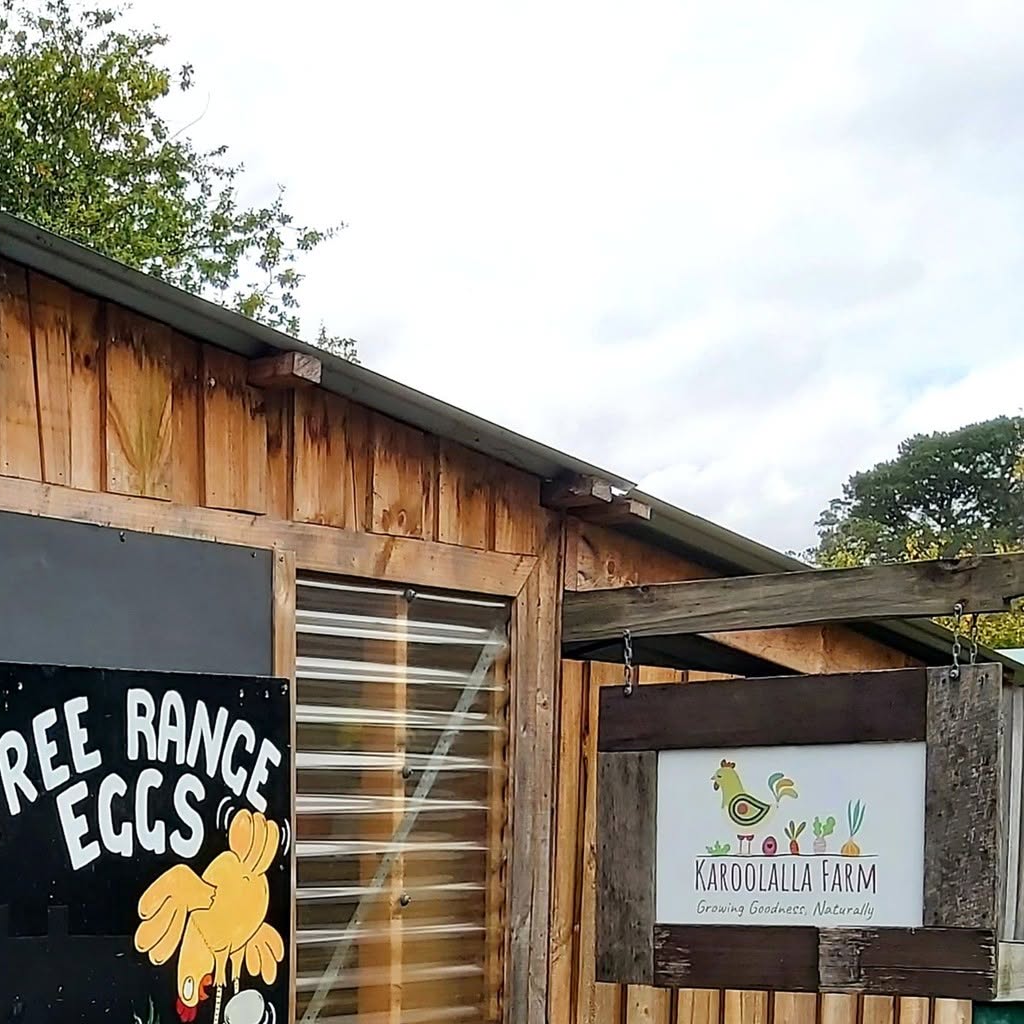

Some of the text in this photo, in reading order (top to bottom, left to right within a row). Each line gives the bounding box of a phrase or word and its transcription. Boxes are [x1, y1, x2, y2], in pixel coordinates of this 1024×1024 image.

[126, 687, 282, 813] RANGE
[56, 768, 206, 871] EGGS
[696, 900, 874, 920] Growing Goodness, Naturally
